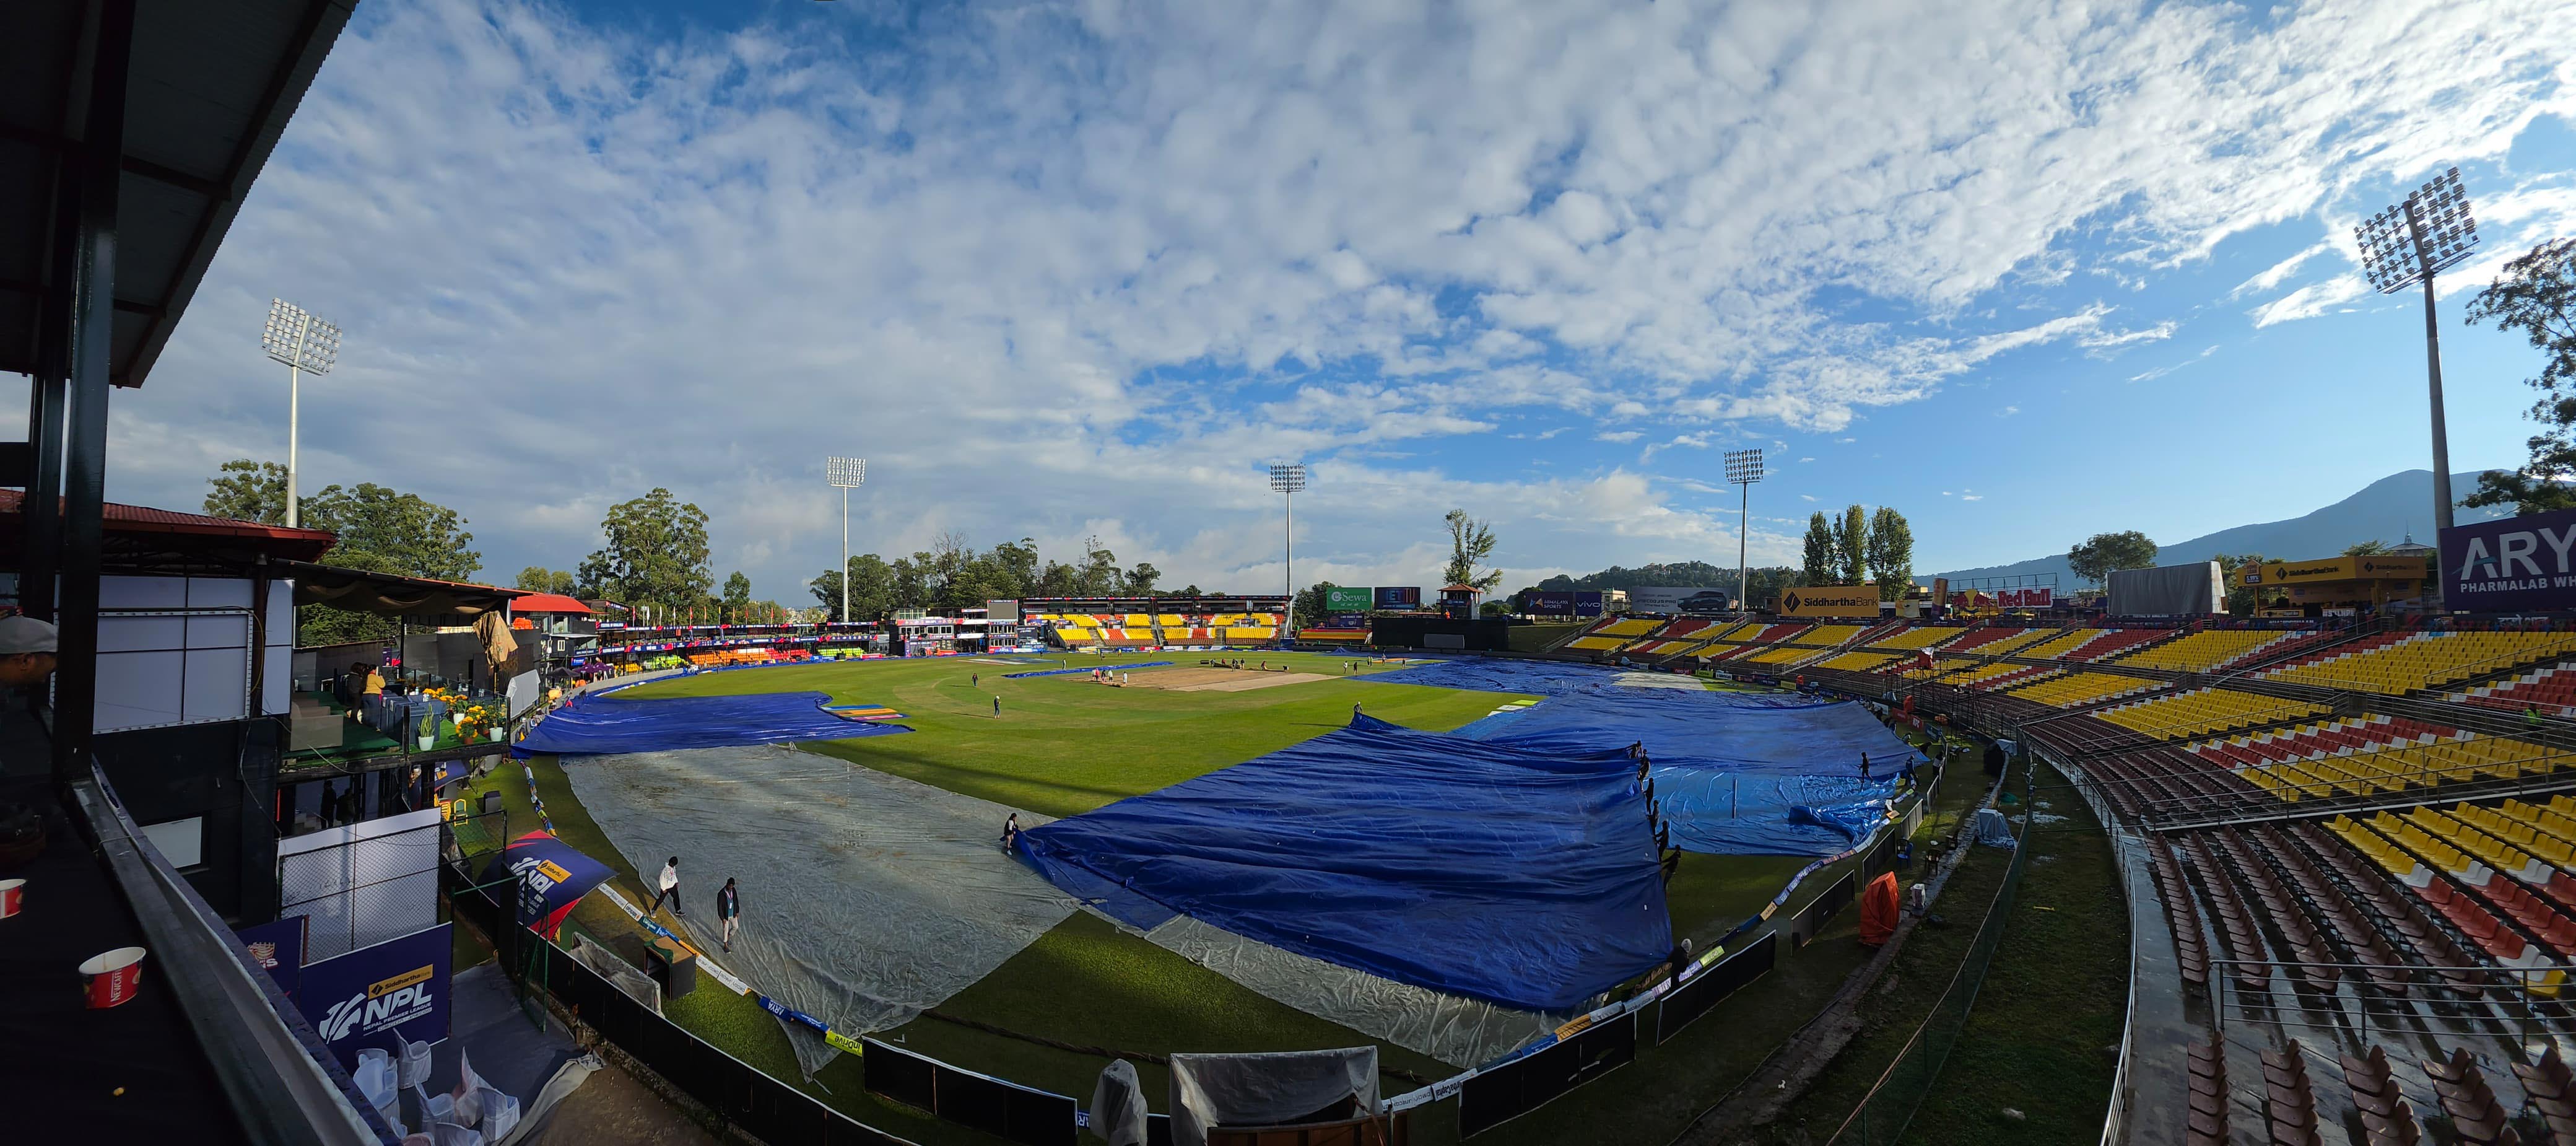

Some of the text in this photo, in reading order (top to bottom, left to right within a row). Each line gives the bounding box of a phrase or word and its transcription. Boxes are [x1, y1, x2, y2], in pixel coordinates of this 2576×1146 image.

[2460, 577, 2548, 593] PHARMALAB
[1998, 588, 2051, 606] Red Bull
[363, 982, 433, 1026] NPL
[768, 1000, 785, 1016] ARYA
[363, 1002, 432, 1032] NEPAL PREMIER LEAGUE
[834, 1035, 861, 1049] inDrive
